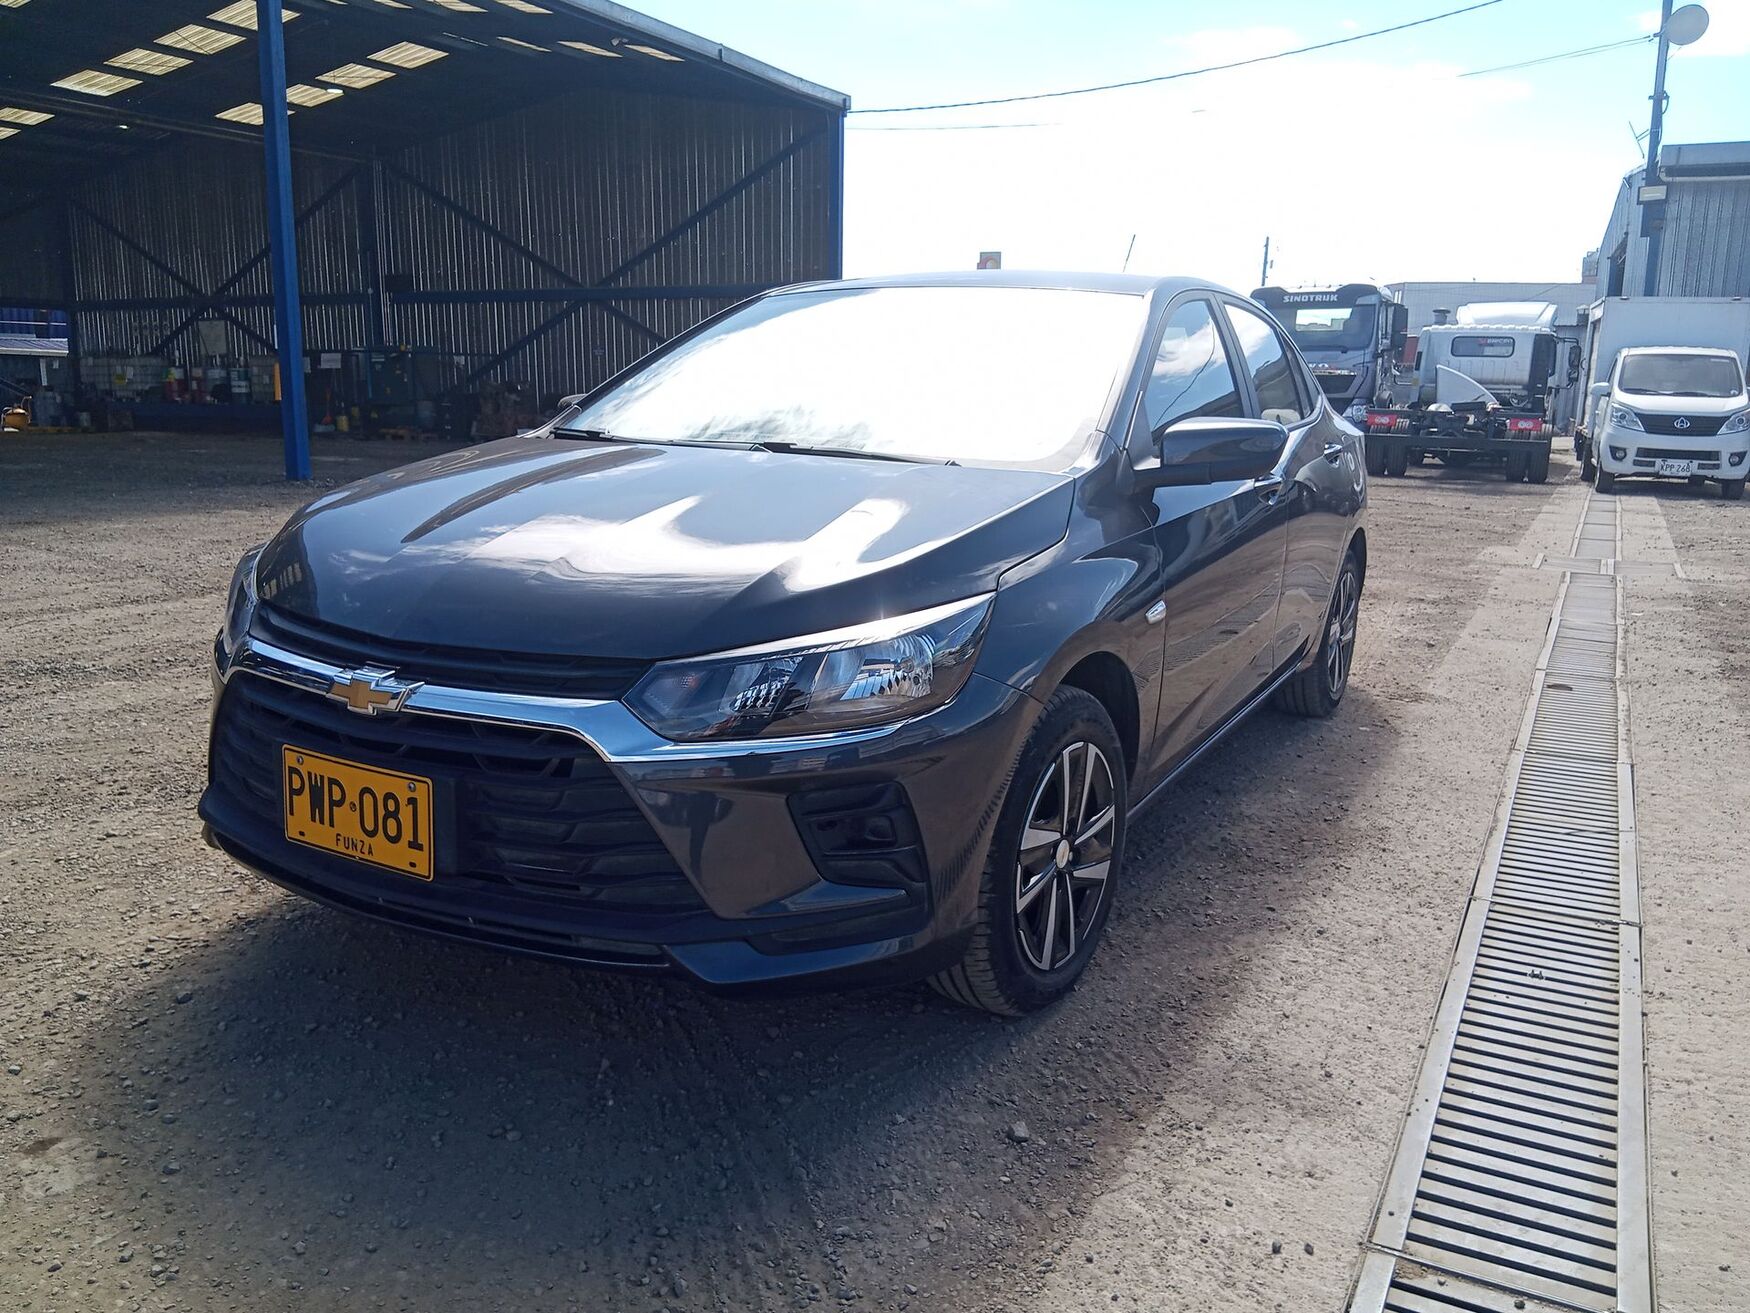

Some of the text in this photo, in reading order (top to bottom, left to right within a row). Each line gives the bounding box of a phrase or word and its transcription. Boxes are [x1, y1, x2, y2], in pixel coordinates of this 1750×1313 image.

[1283, 294, 1338, 303] SINOTRUK
[288, 766, 424, 852] PWP 081
[335, 833, 374, 857] FUNZA
